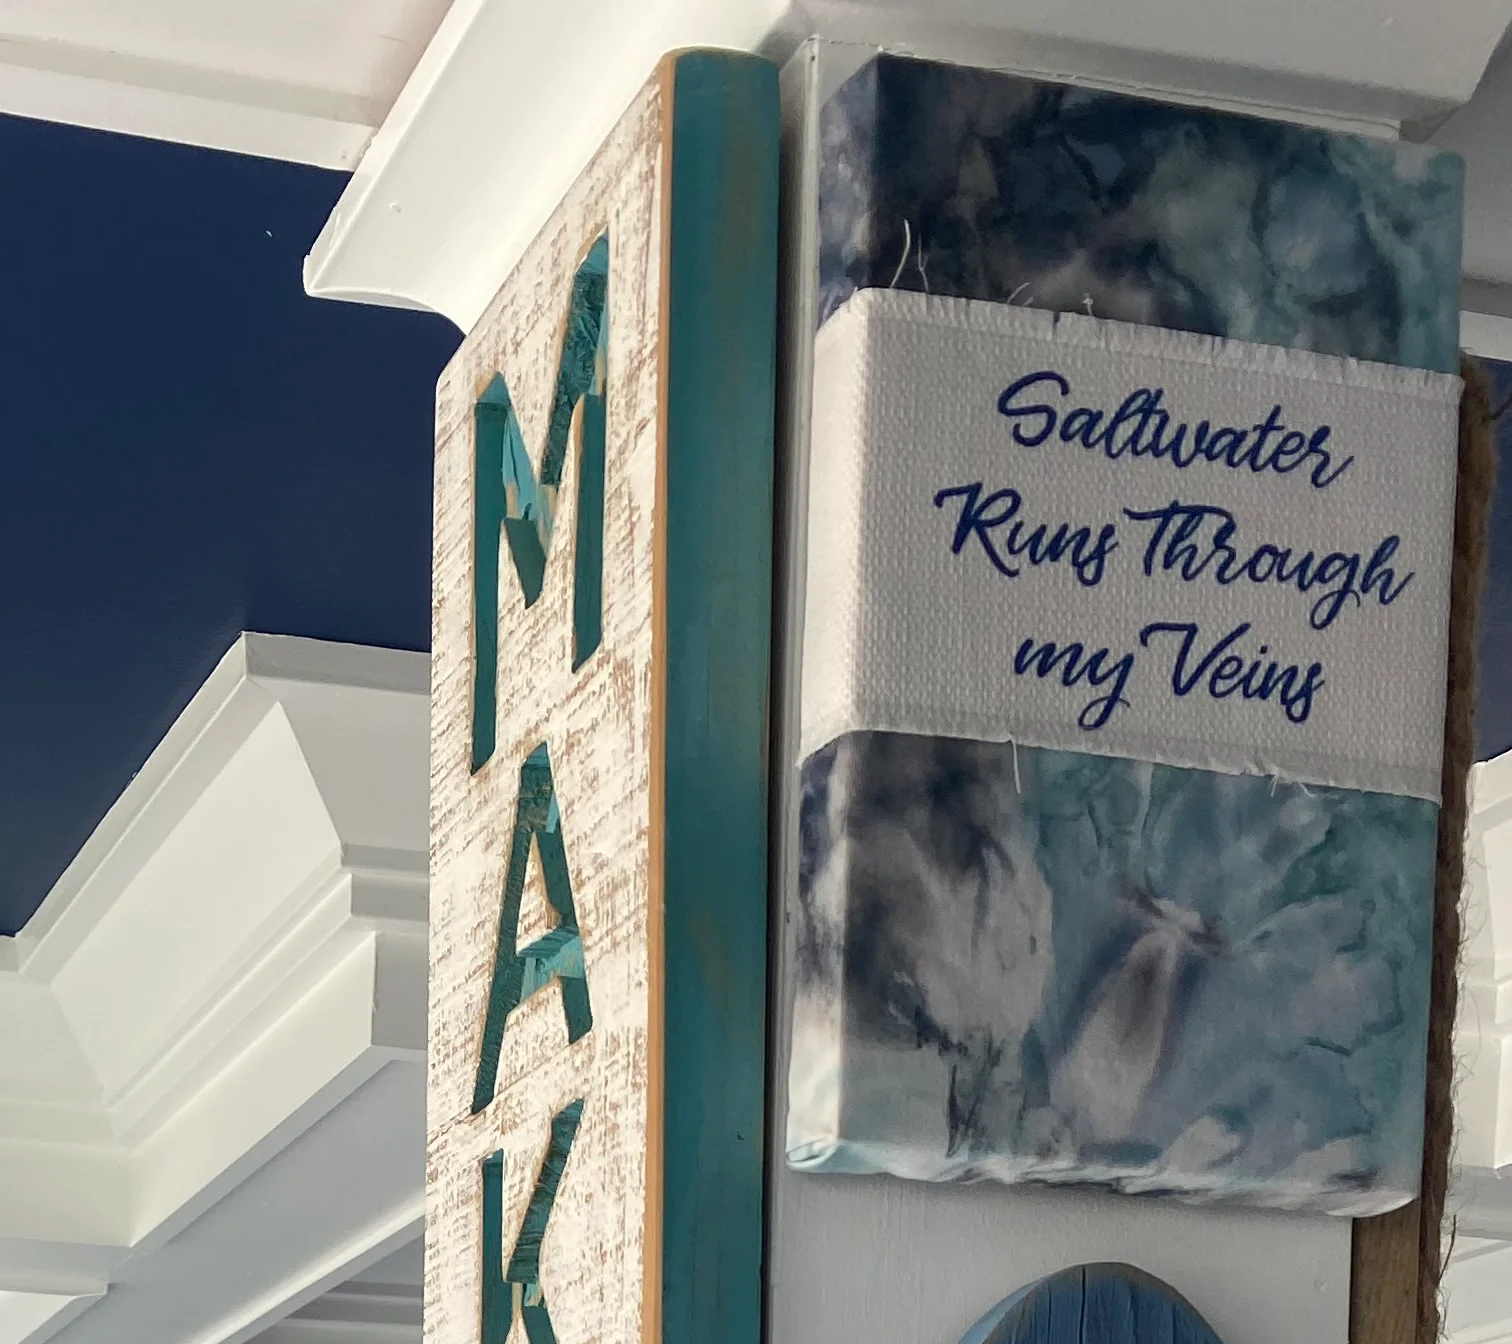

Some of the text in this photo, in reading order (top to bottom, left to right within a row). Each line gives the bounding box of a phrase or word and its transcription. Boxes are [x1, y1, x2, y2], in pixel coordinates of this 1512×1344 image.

[996, 370, 1355, 488] Saltwater
[933, 481, 1416, 630] Runs Through
[1012, 620, 1325, 730] my Veins
